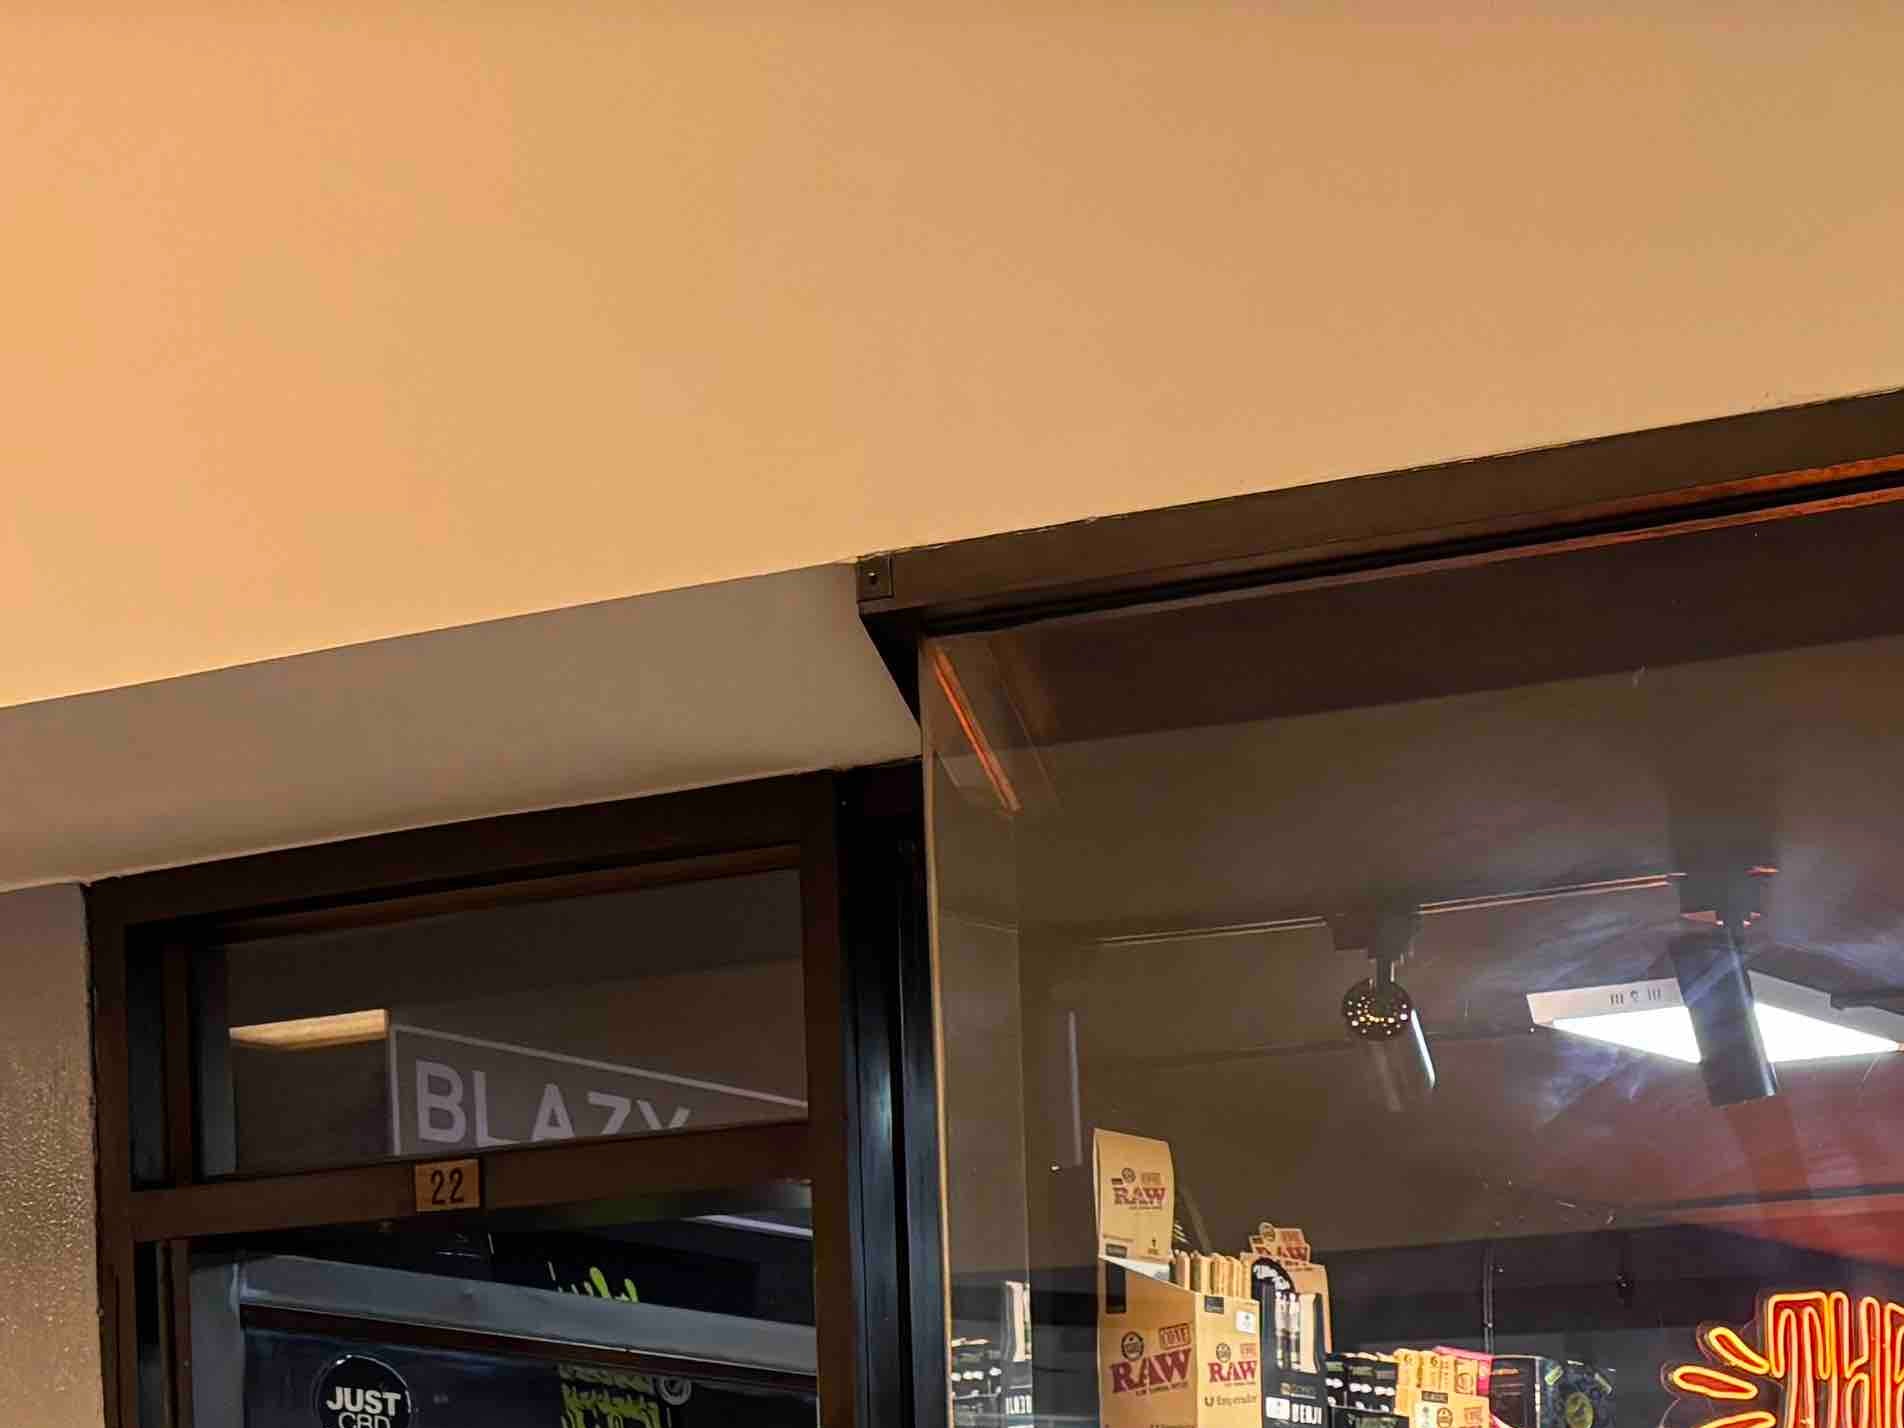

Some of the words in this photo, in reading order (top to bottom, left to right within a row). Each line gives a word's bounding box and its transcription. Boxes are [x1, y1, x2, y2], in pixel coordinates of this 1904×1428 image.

[430, 1167, 464, 1205] 22
[1110, 1348, 1192, 1394] RAW
[1208, 1359, 1257, 1384] RAW
[326, 1386, 401, 1417] JUST
